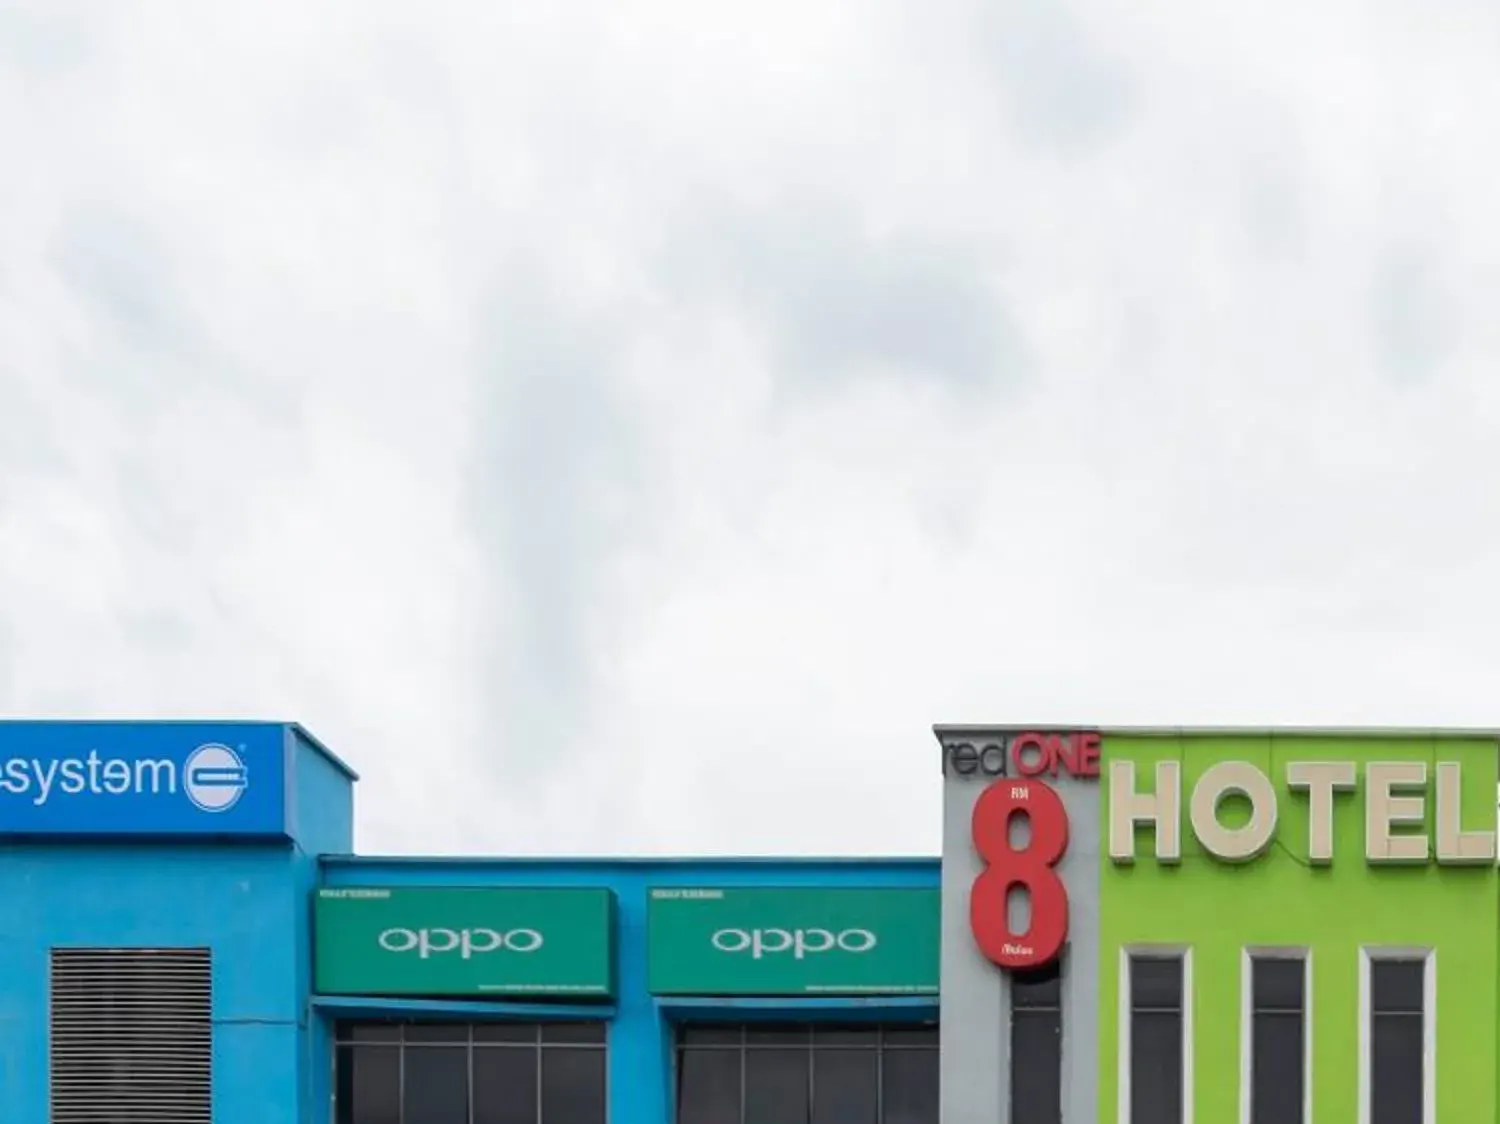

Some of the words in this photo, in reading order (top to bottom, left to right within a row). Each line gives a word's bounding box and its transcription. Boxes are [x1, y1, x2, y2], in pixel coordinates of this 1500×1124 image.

[943, 735, 1006, 775] red
[1012, 732, 1100, 776] ONE
[1109, 760, 1496, 866] HOTEL
[971, 777, 1070, 966] 8
